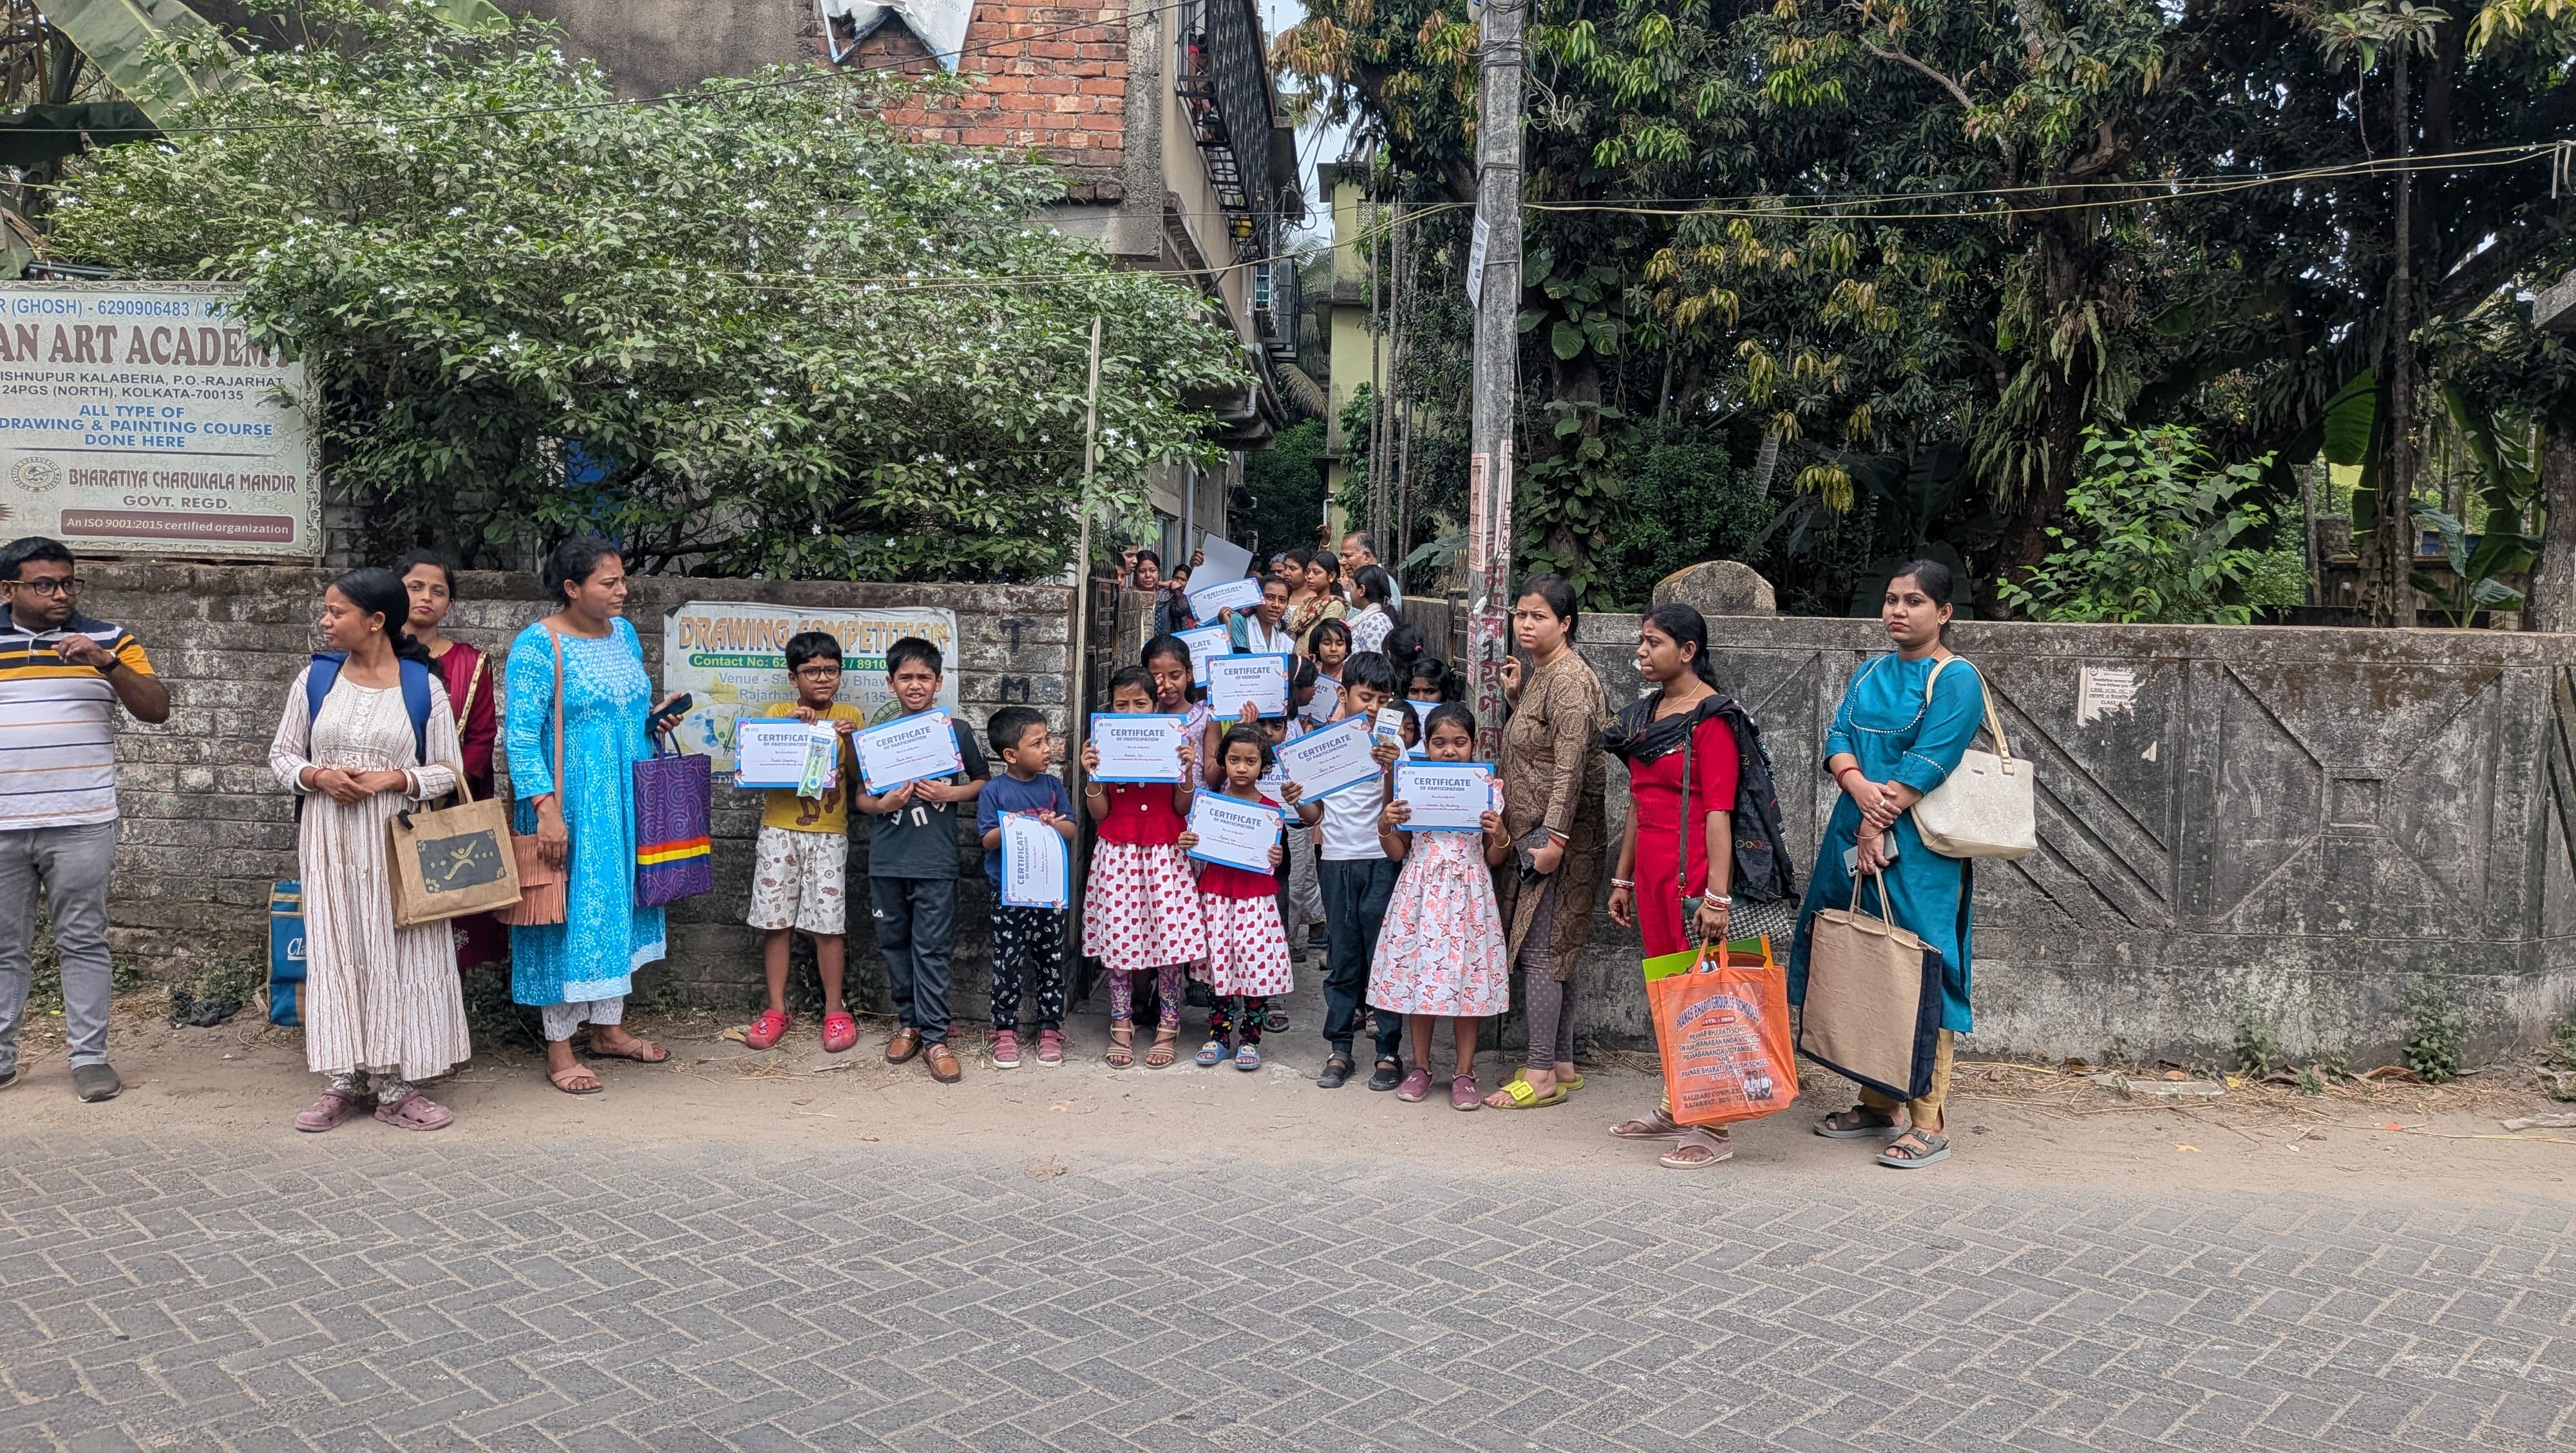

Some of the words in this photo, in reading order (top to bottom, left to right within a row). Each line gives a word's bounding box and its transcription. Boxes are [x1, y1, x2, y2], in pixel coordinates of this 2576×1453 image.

[12, 299, 82, 318] (GHOSH)
[98, 300, 189, 316] 6290906483
[48, 324, 117, 364] ART
[80, 373, 168, 386] KALABERIA,
[3, 385, 48, 395] 24PGS
[53, 386, 117, 399] (NORTH),
[122, 388, 243, 400] KOLKATA-700135
[79, 405, 109, 416] ALL
[115, 406, 155, 417] TYPE
[161, 406, 185, 418] OF
[0, 417, 84, 430] DRAWING
[91, 421, 103, 431] &
[111, 421, 196, 433] PAINTING
[204, 423, 272, 435] COURSE
[85, 434, 135, 446] DONE
[142, 435, 185, 447] HERE
[69, 469, 147, 488] BHARATIYA
[153, 471, 234, 491] CHARUKALA
[240, 473, 296, 494] MANDIR
[123, 495, 175, 507] GOVT.
[182, 498, 232, 509] REGD.
[67, 518, 81, 527] An
[84, 518, 103, 527] ISO
[105, 519, 162, 529] 9001:2015
[165, 522, 213, 531] certified
[215, 523, 289, 534] organization
[679, 616, 790, 652] DRAWING
[694, 656, 743, 667] Contact
[747, 656, 768, 667] No:
[719, 673, 759, 684] Venue
[1224, 667, 1271, 676] CERTIFICATE
[864, 692, 886, 703] 135
[876, 726, 931, 747] CERTIFICATE
[1298, 734, 1352, 760] CERTIFICATE
[1414, 777, 1471, 786] CERTIFICATE
[1209, 808, 1262, 826] CERTIFICATE
[1016, 831, 1025, 885] CERTIFICATE
